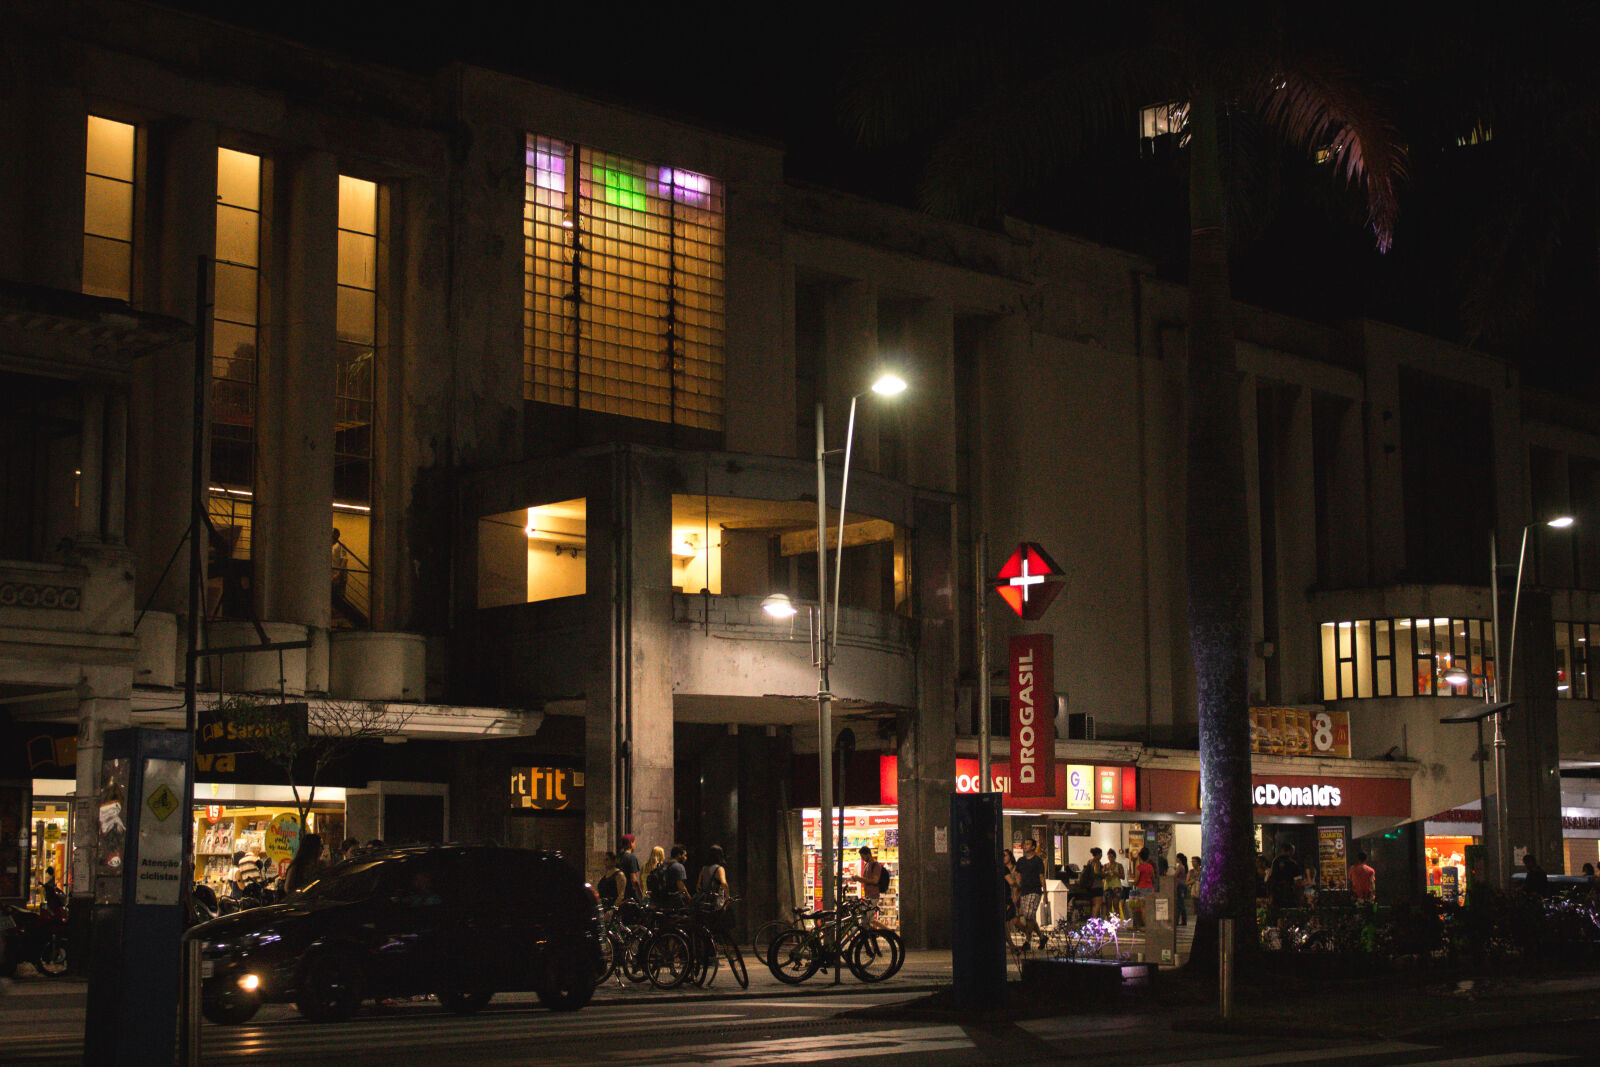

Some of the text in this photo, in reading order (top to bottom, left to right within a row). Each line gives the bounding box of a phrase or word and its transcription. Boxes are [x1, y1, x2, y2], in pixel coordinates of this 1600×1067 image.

[1018, 648, 1036, 784] DROGASIL
[1070, 771, 1080, 788] G
[1251, 783, 1341, 807] cDonald's
[142, 859, 179, 871] Atenção
[140, 872, 178, 881] ciclistas
